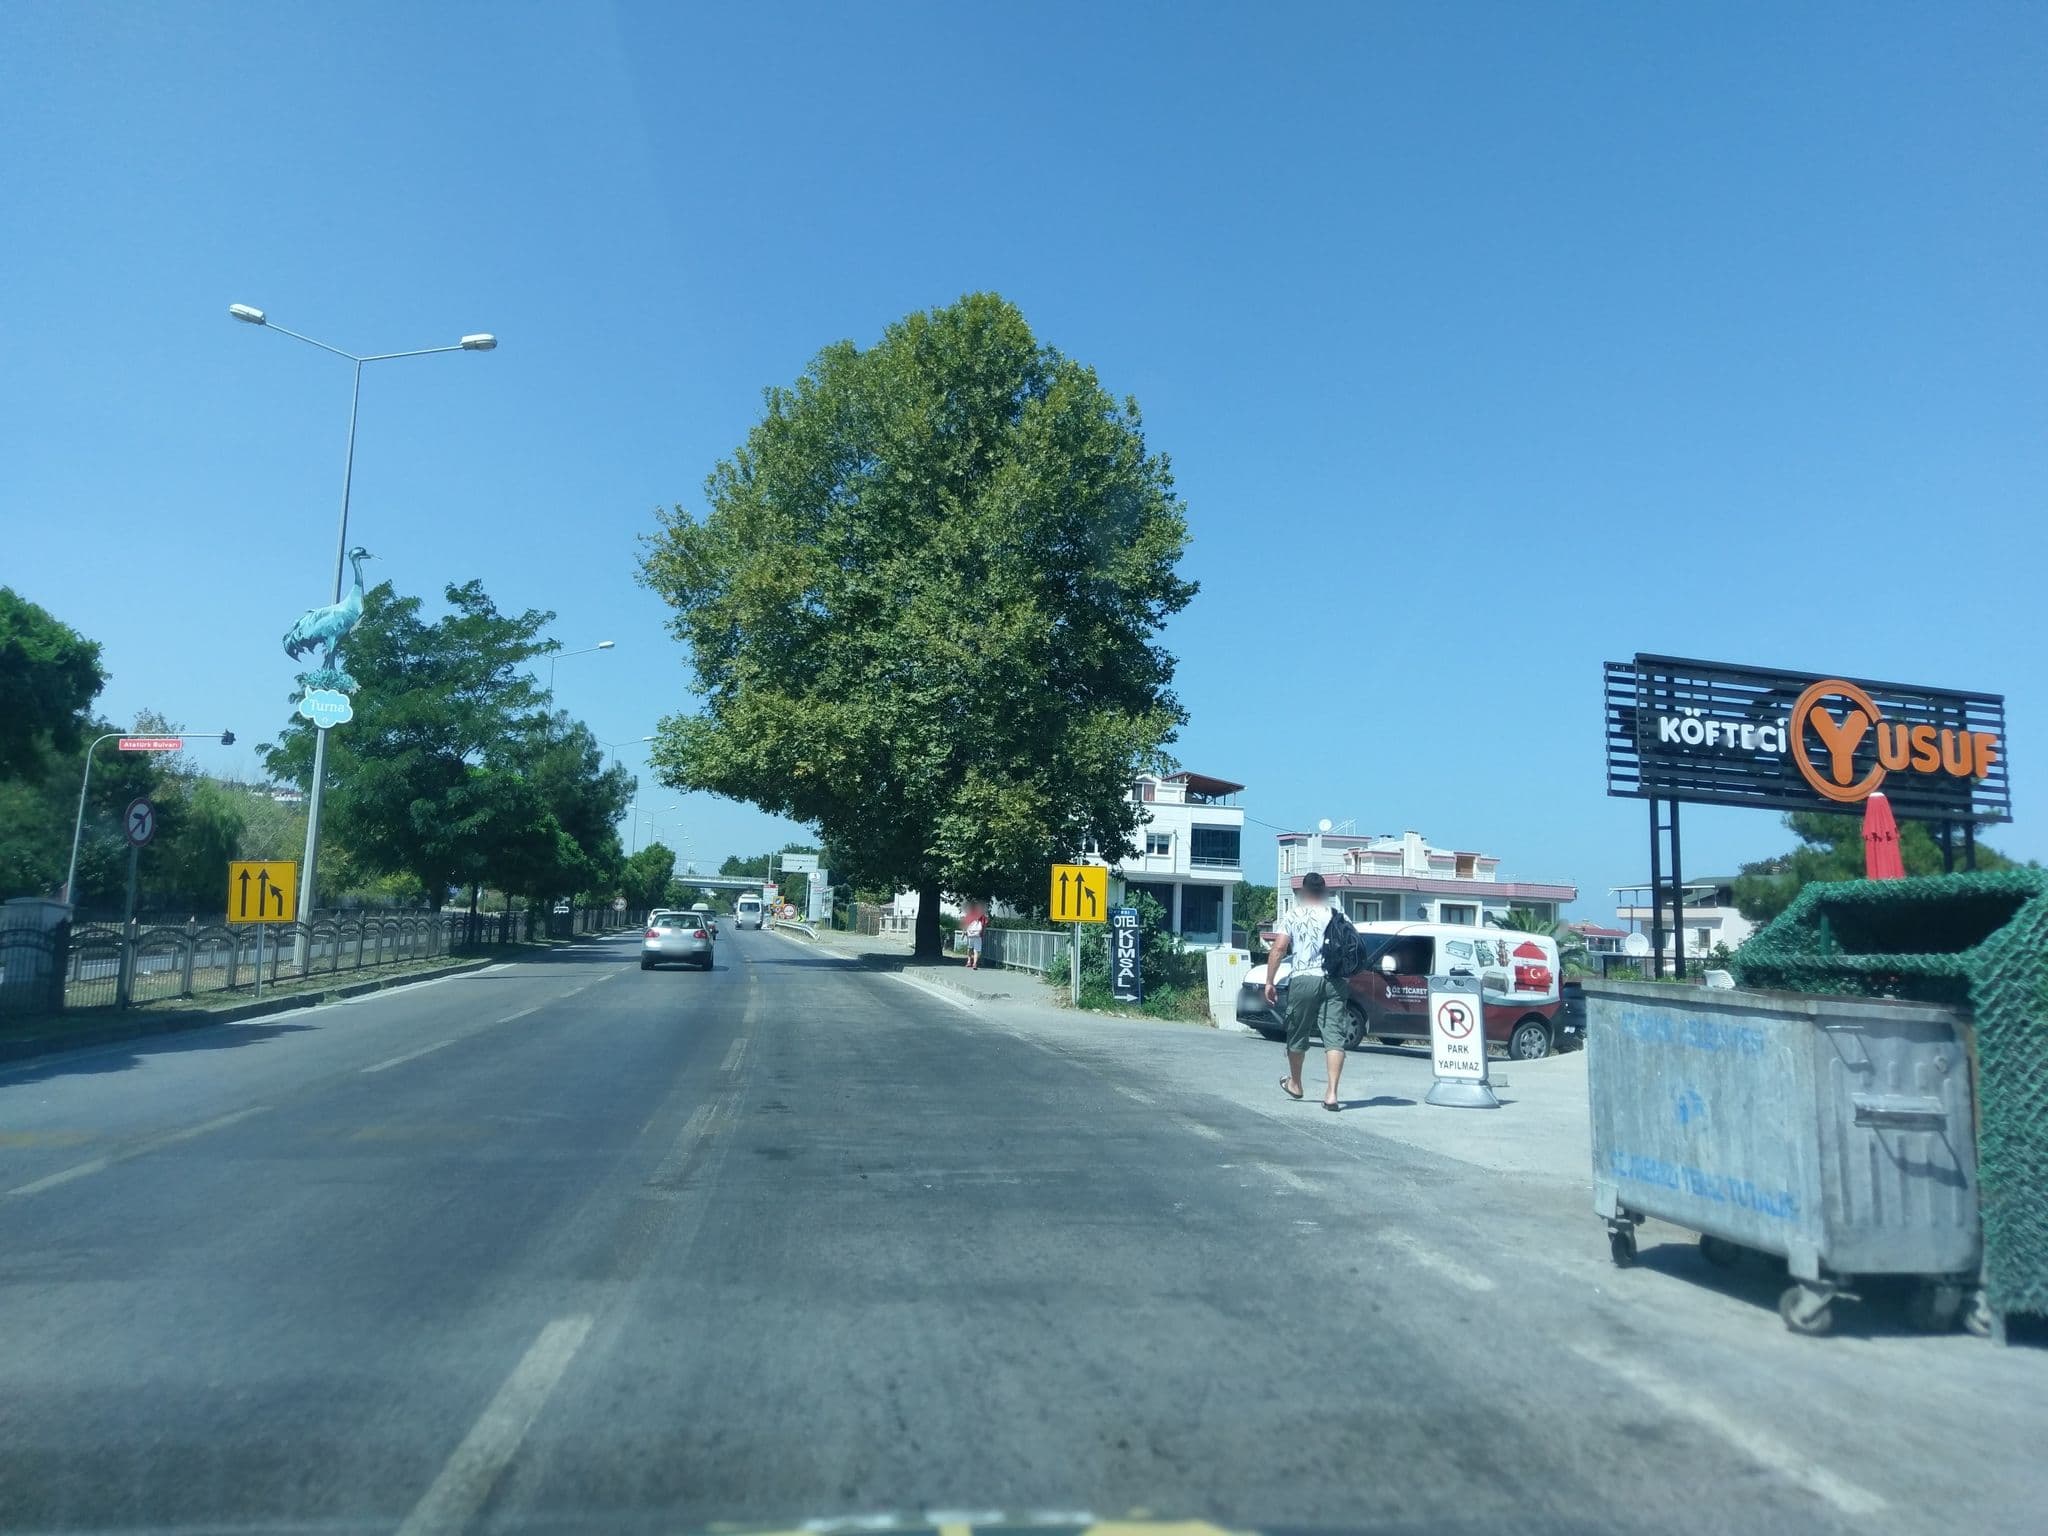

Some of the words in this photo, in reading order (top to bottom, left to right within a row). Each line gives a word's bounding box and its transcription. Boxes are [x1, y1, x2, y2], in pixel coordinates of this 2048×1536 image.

[309, 698, 345, 713] Turna
[1658, 706, 1787, 753] KÖFTECİ
[123, 740, 152, 748] Atatürk
[153, 740, 178, 748] Bulvarı
[1113, 915, 1138, 928] OTEL
[1117, 929, 1136, 988] KUMSAL
[1402, 985, 1428, 994] TİCARET
[1449, 1008, 1465, 1031] P
[1447, 1044, 1470, 1054] PARK
[1438, 1061, 1480, 1072] YAPILMAZ
